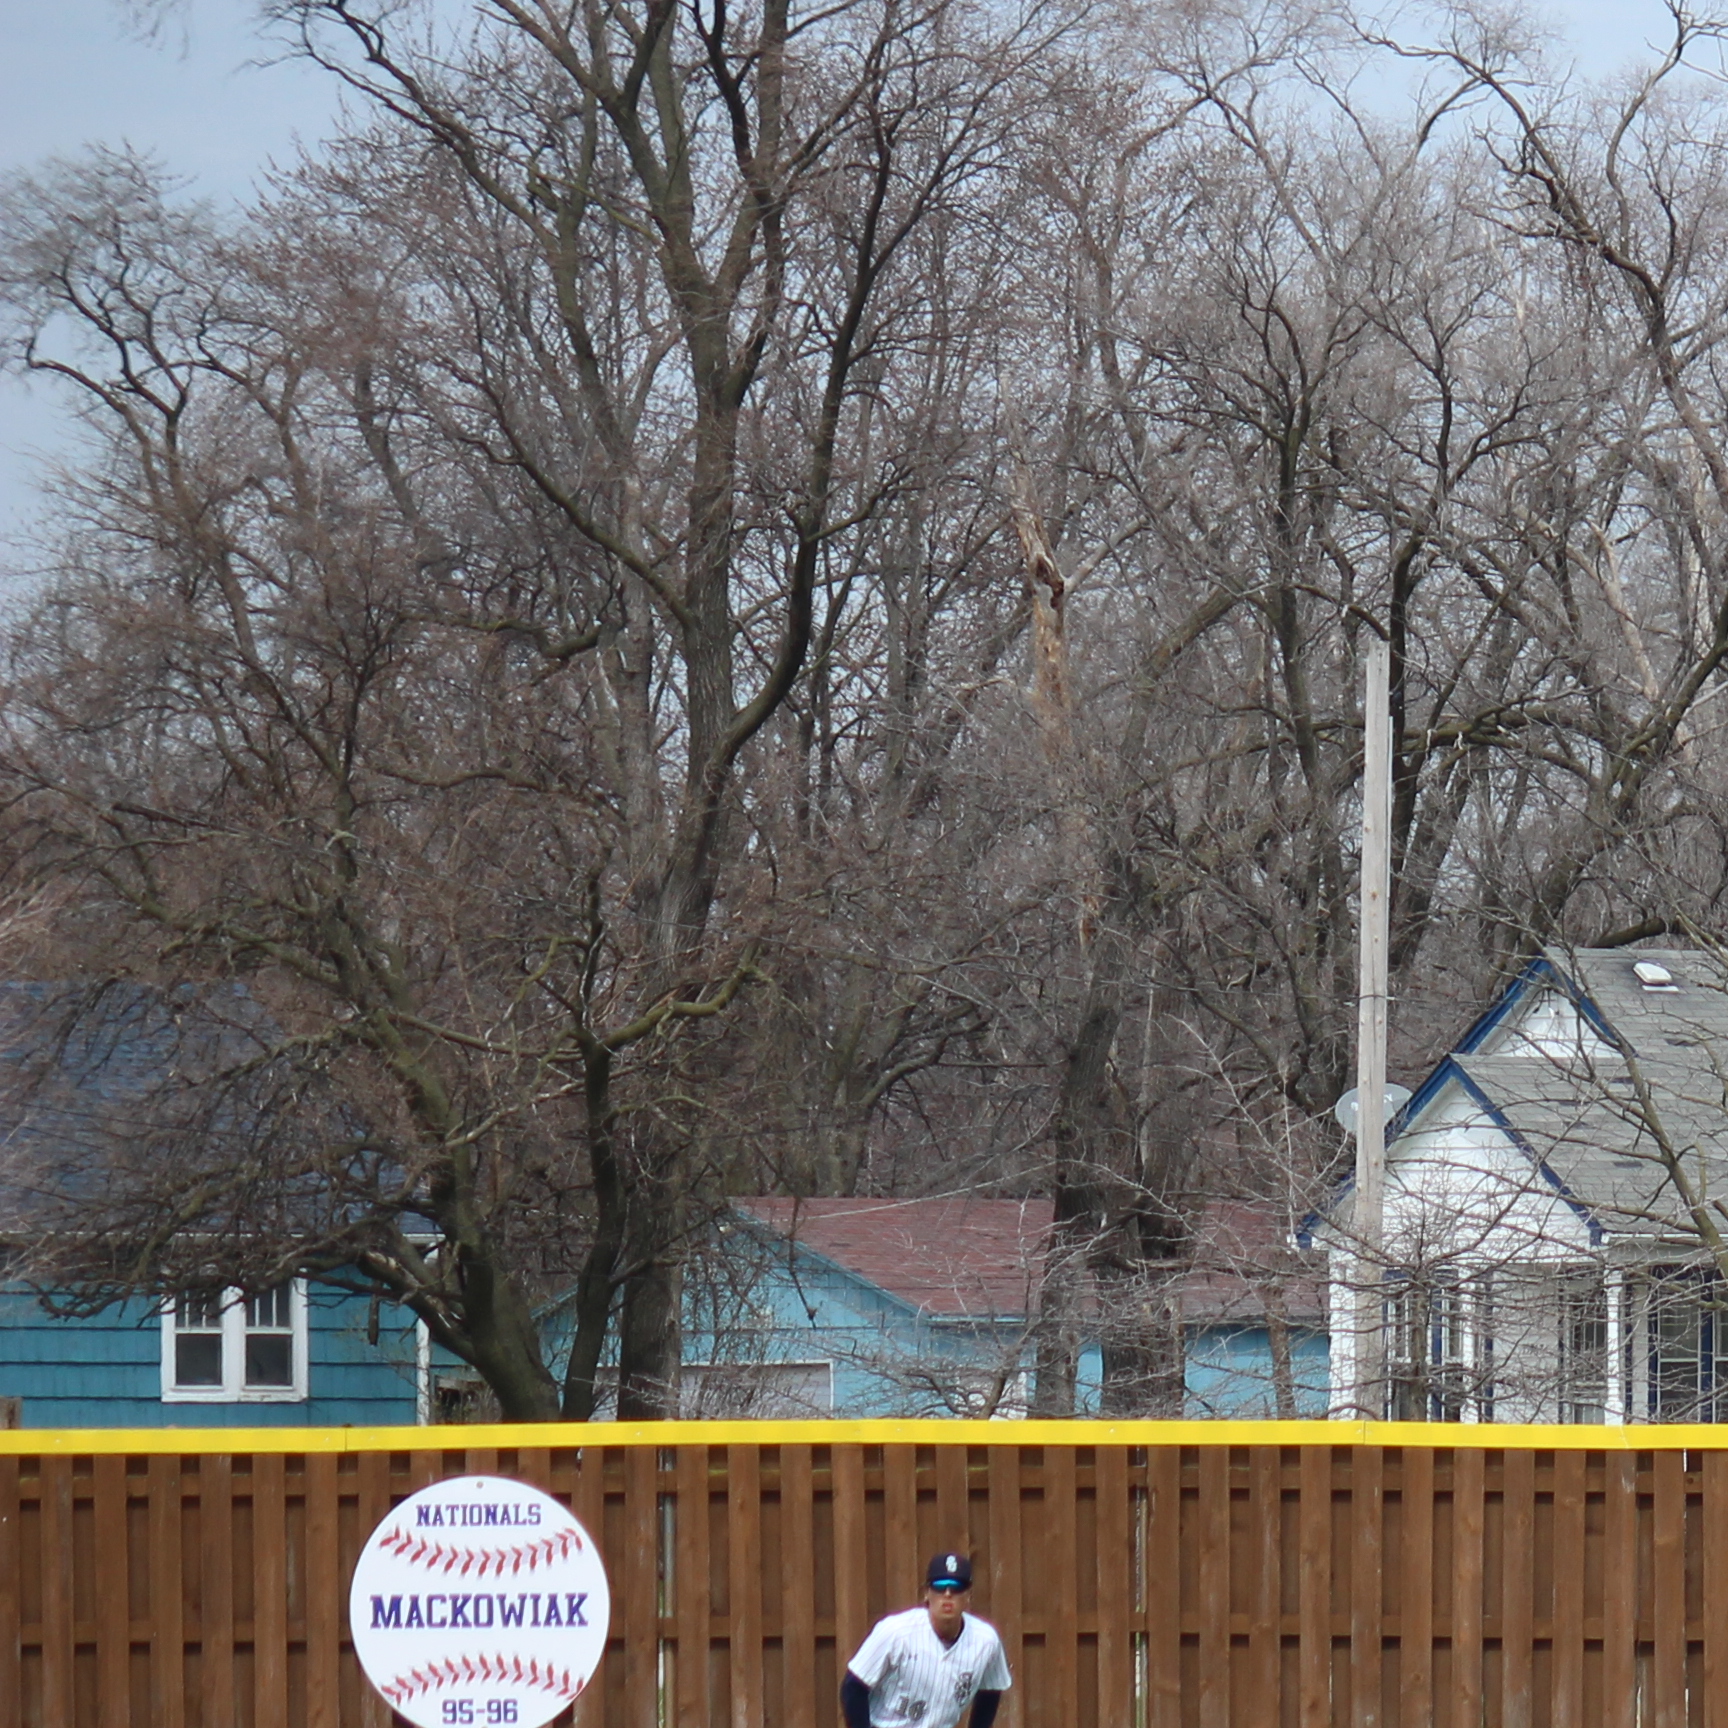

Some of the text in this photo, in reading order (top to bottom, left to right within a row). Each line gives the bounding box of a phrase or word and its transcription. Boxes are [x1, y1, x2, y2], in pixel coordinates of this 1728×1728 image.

[416, 1503, 541, 1527] NATIONALS
[369, 1593, 589, 1629] MACKOWIAK
[441, 1698, 519, 1724] 95-96
